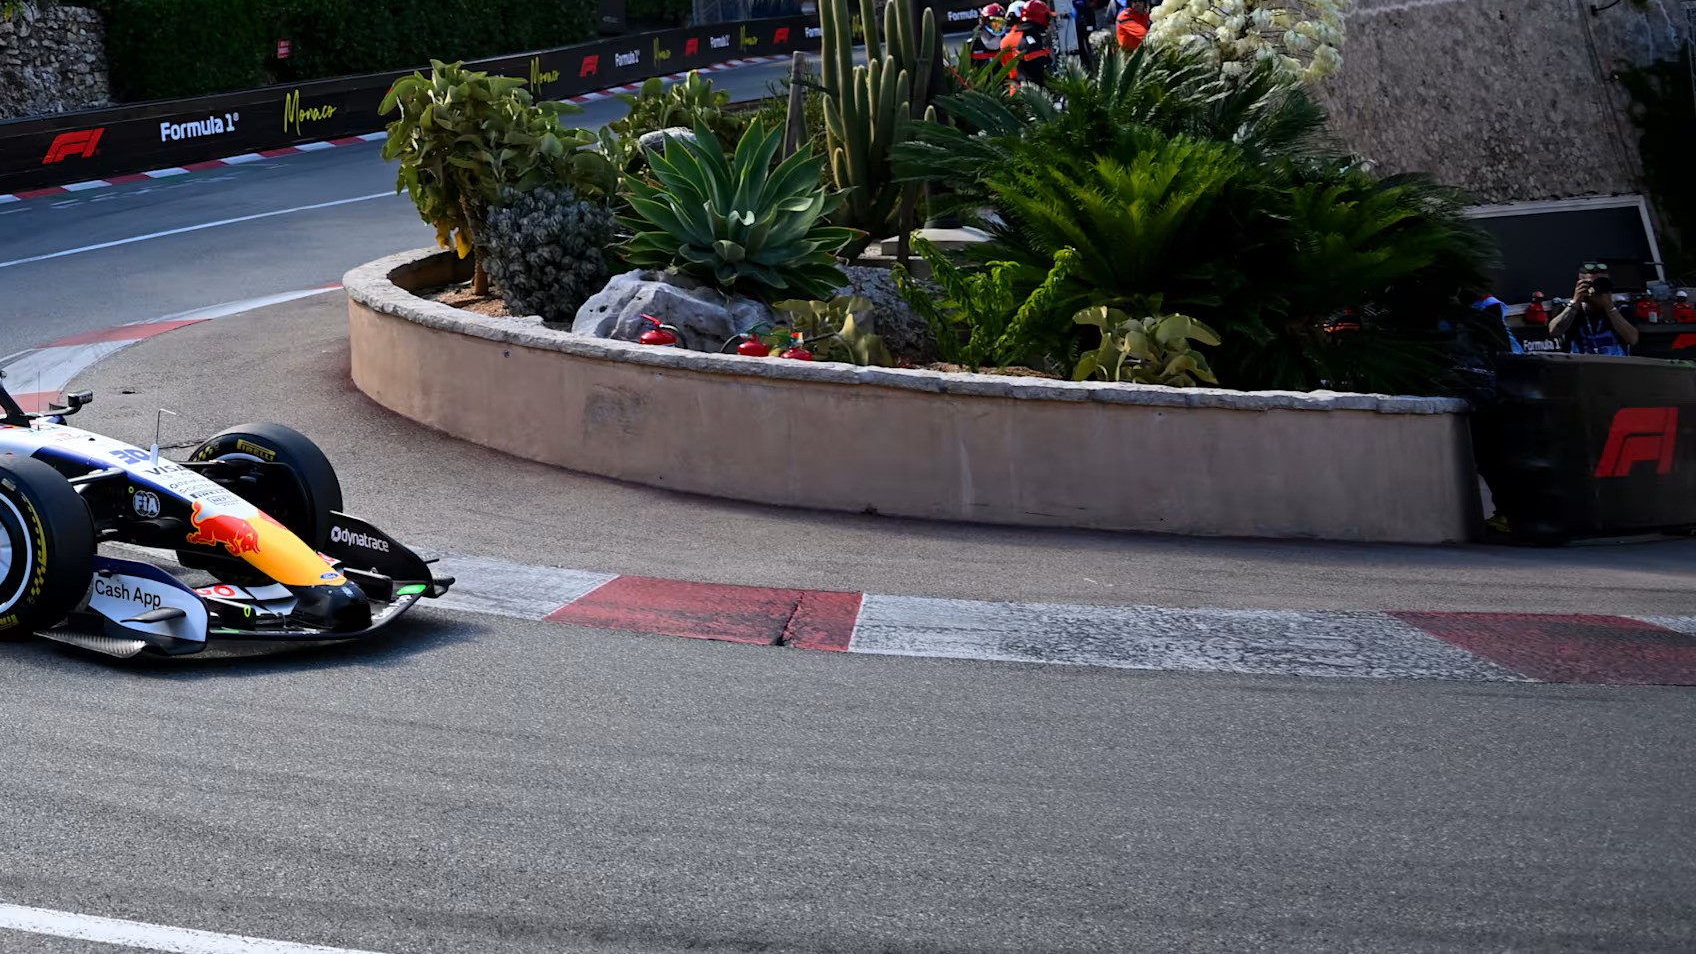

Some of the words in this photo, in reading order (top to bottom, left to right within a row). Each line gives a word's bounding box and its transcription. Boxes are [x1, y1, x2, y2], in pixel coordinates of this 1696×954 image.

[283, 89, 337, 136] Monaco
[160, 116, 224, 142] Formula
[1524, 339, 1554, 352] Formula
[237, 439, 276, 461] PIRELLI
[135, 497, 157, 515] FIA
[341, 528, 390, 553] dynatrace
[95, 579, 129, 601] Cash
[133, 587, 161, 610] App
